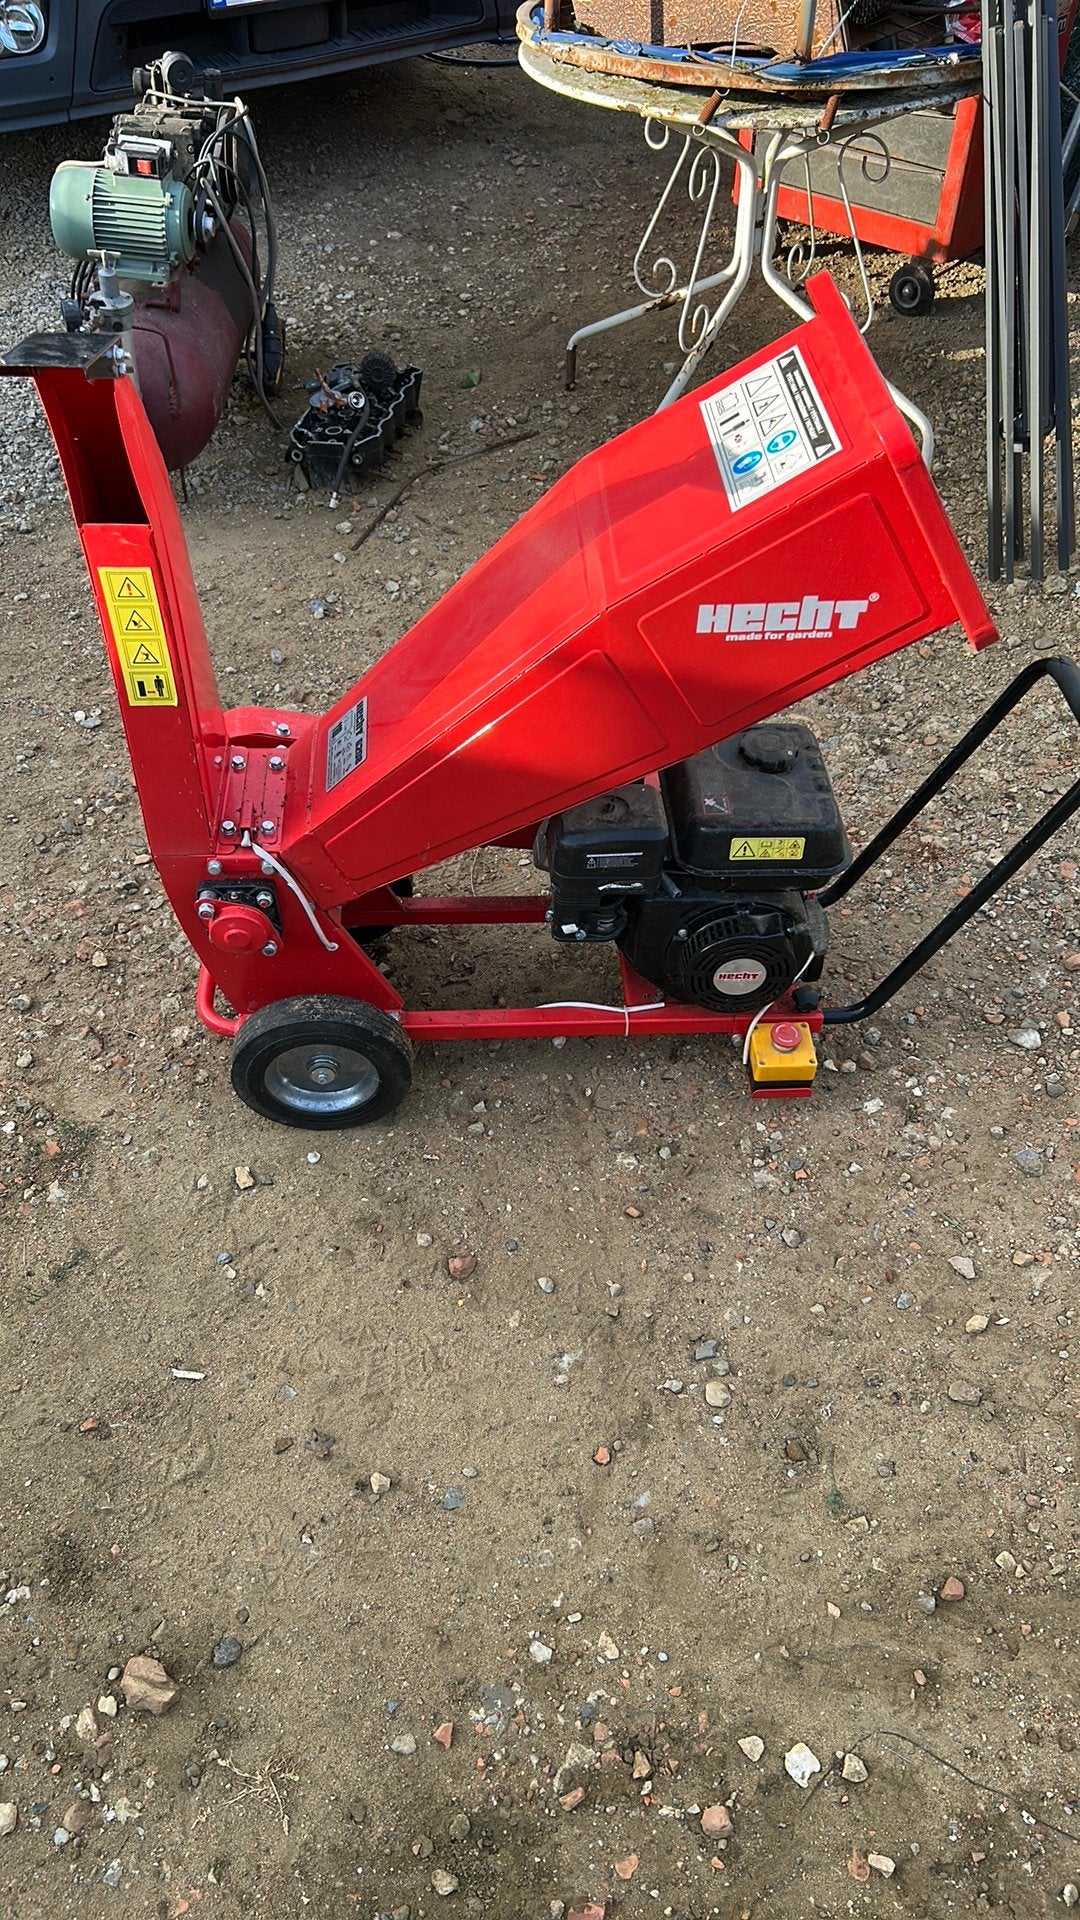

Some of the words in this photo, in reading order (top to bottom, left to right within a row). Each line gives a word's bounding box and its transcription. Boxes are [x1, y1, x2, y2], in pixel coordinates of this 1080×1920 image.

[725, 632, 762, 642] made
[764, 631, 785, 640] for
[785, 630, 833, 641] garden
